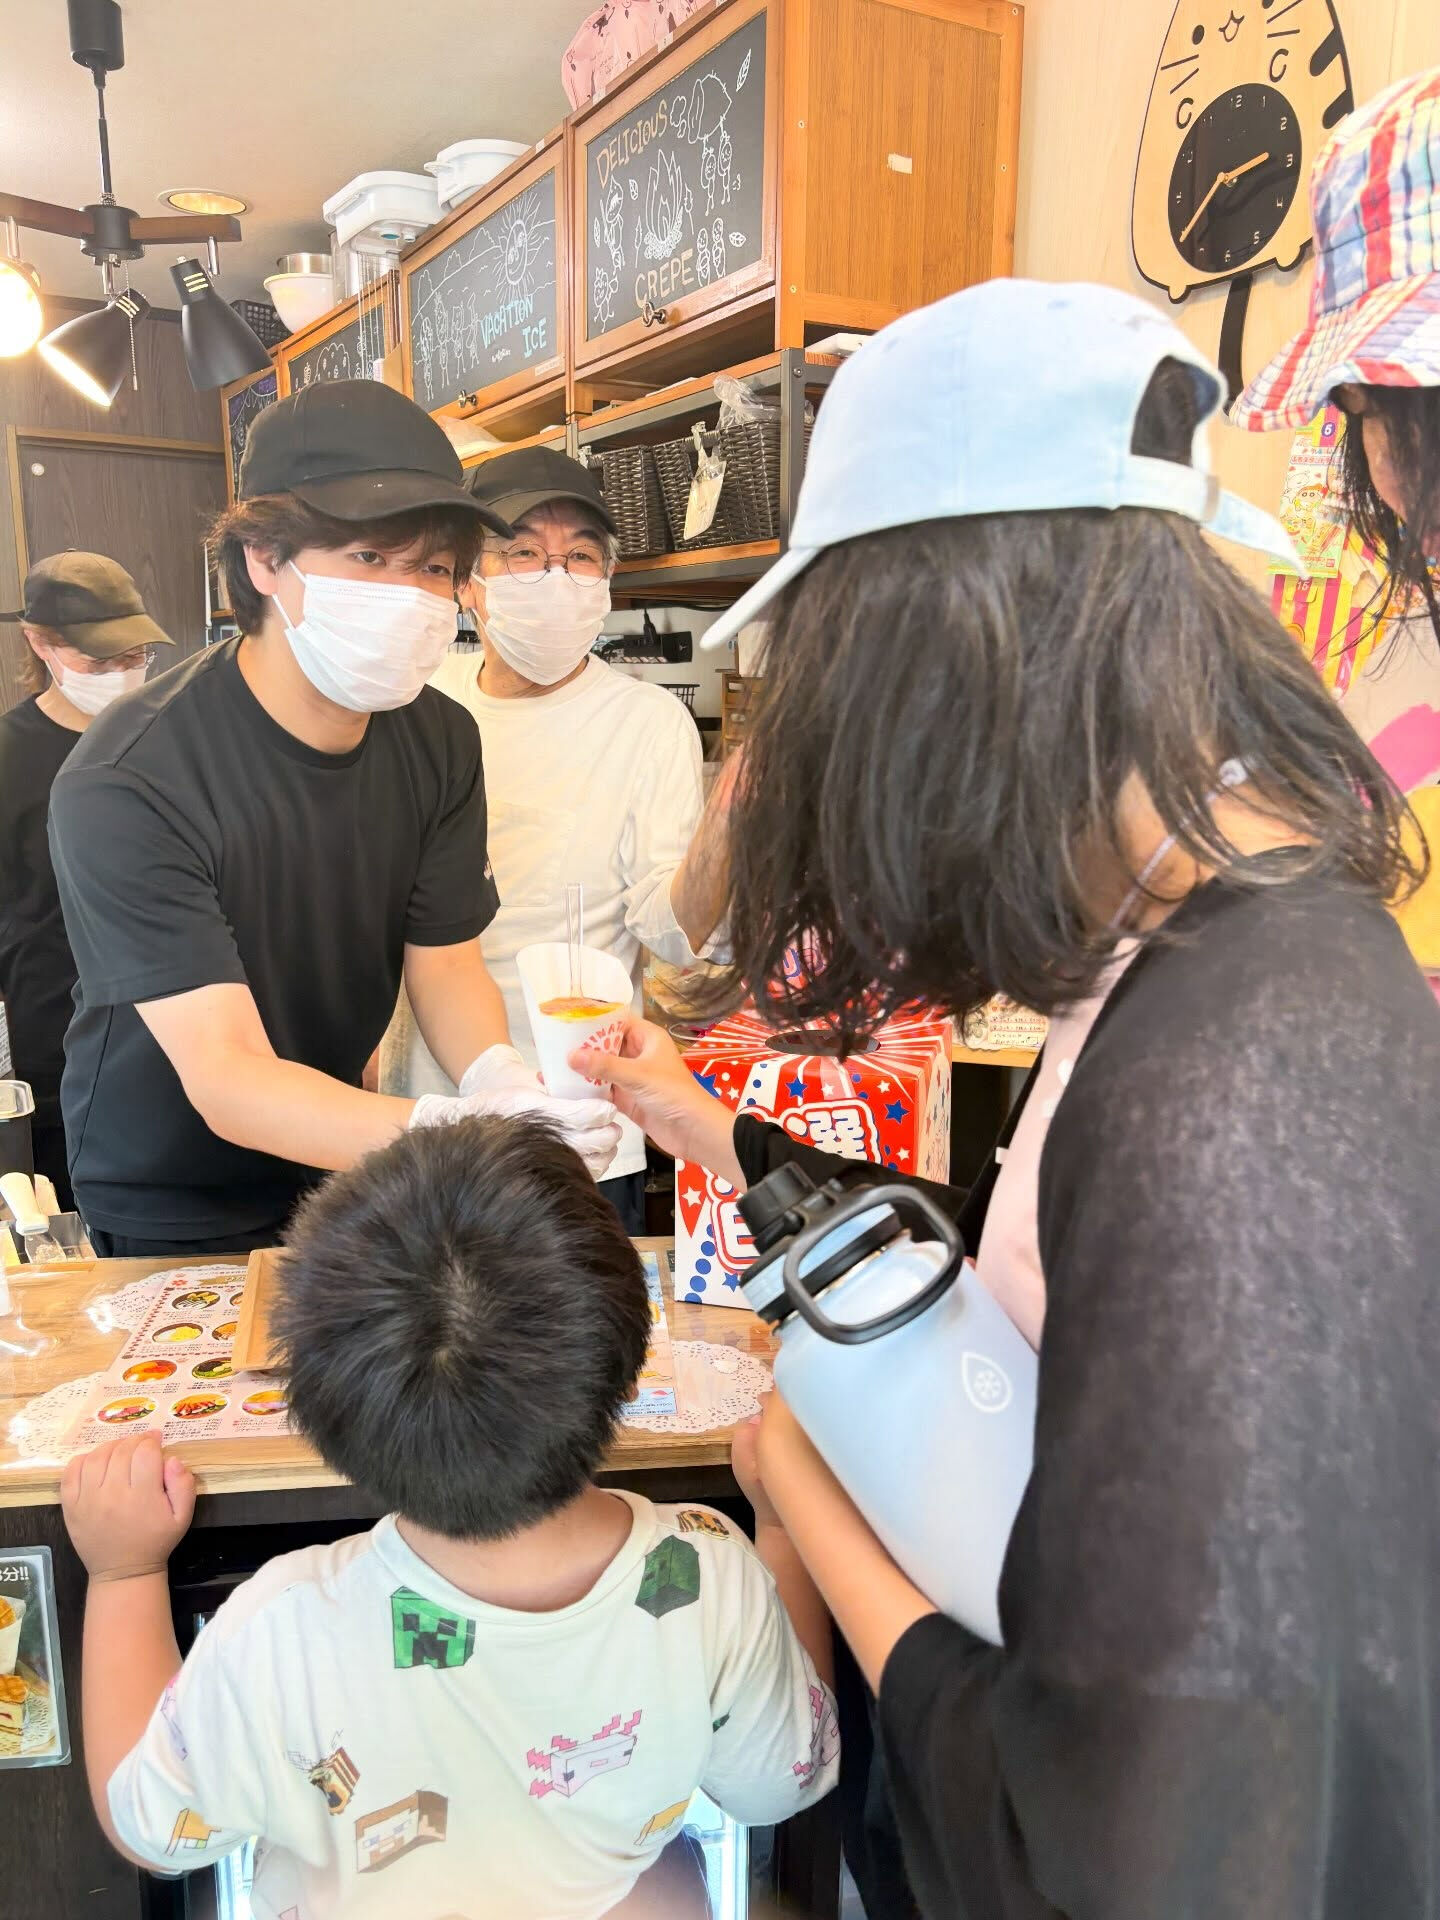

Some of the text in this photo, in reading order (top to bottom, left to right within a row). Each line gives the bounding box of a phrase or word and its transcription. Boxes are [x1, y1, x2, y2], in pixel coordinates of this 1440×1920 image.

[1230, 94, 1243, 109] 12
[1262, 95, 1267, 109] 1
[1280, 116, 1288, 131] 2
[596, 99, 668, 190] DELICIOUS
[1285, 153, 1294, 168] 3
[635, 248, 695, 309] CREPE
[479, 294, 534, 349] VACATION
[522, 317, 548, 359] ICE
[1324, 424, 1333, 436] 6
[0, 1566, 29, 1582] 分!!
